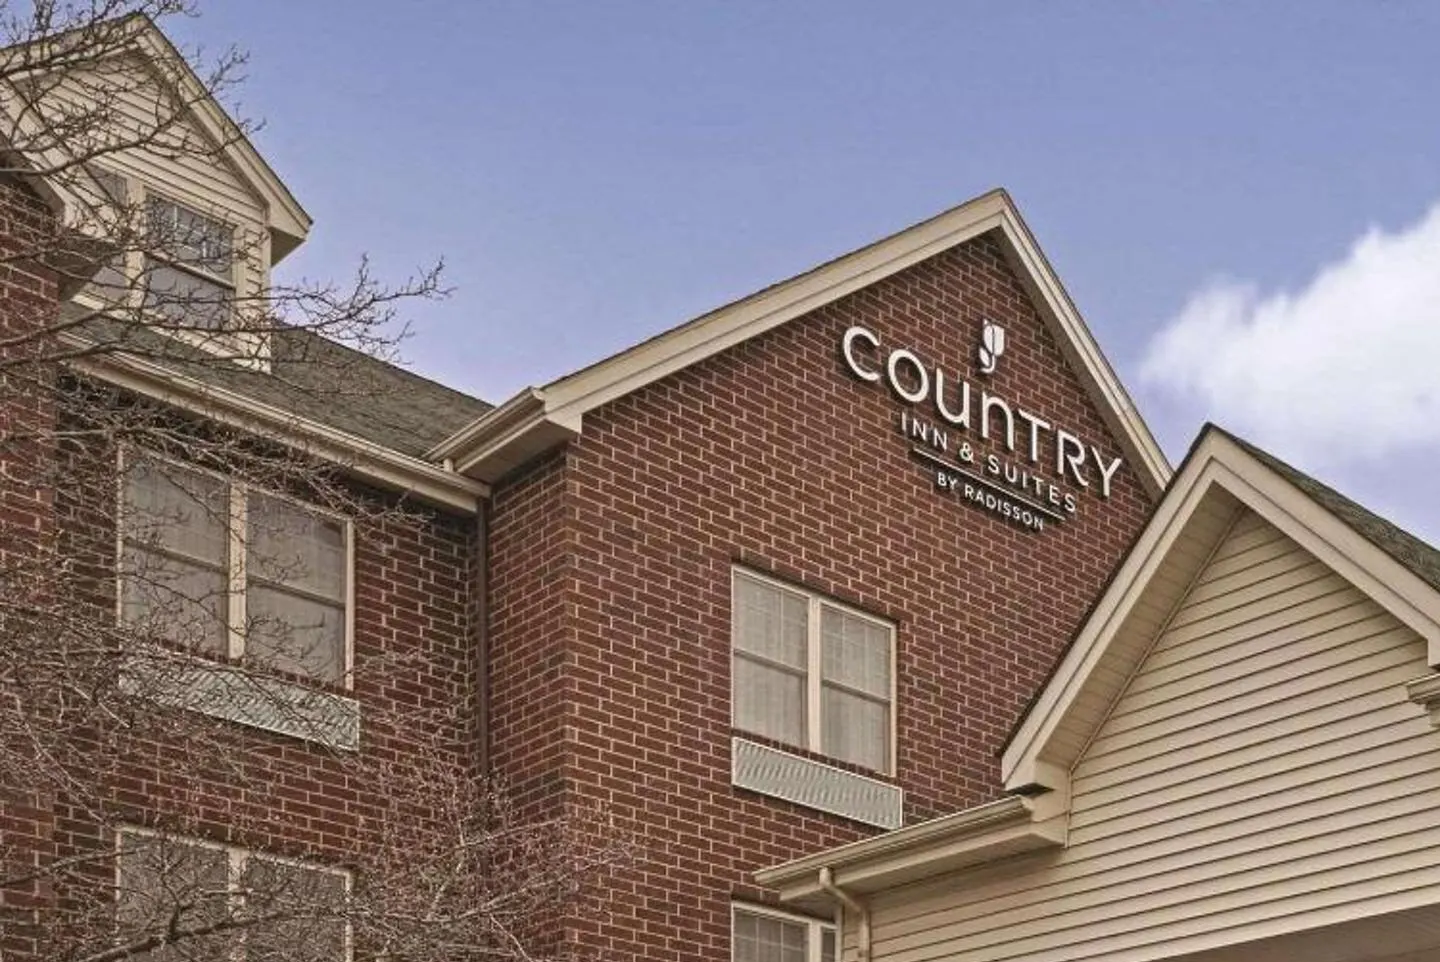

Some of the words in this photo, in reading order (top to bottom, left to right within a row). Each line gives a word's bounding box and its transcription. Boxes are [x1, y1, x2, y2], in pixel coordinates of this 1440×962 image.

[901, 412, 948, 450] INN
[959, 443, 974, 463] &
[988, 454, 1077, 513] SUITES
[938, 472, 958, 489] BY
[964, 486, 1044, 531] RADISSON
